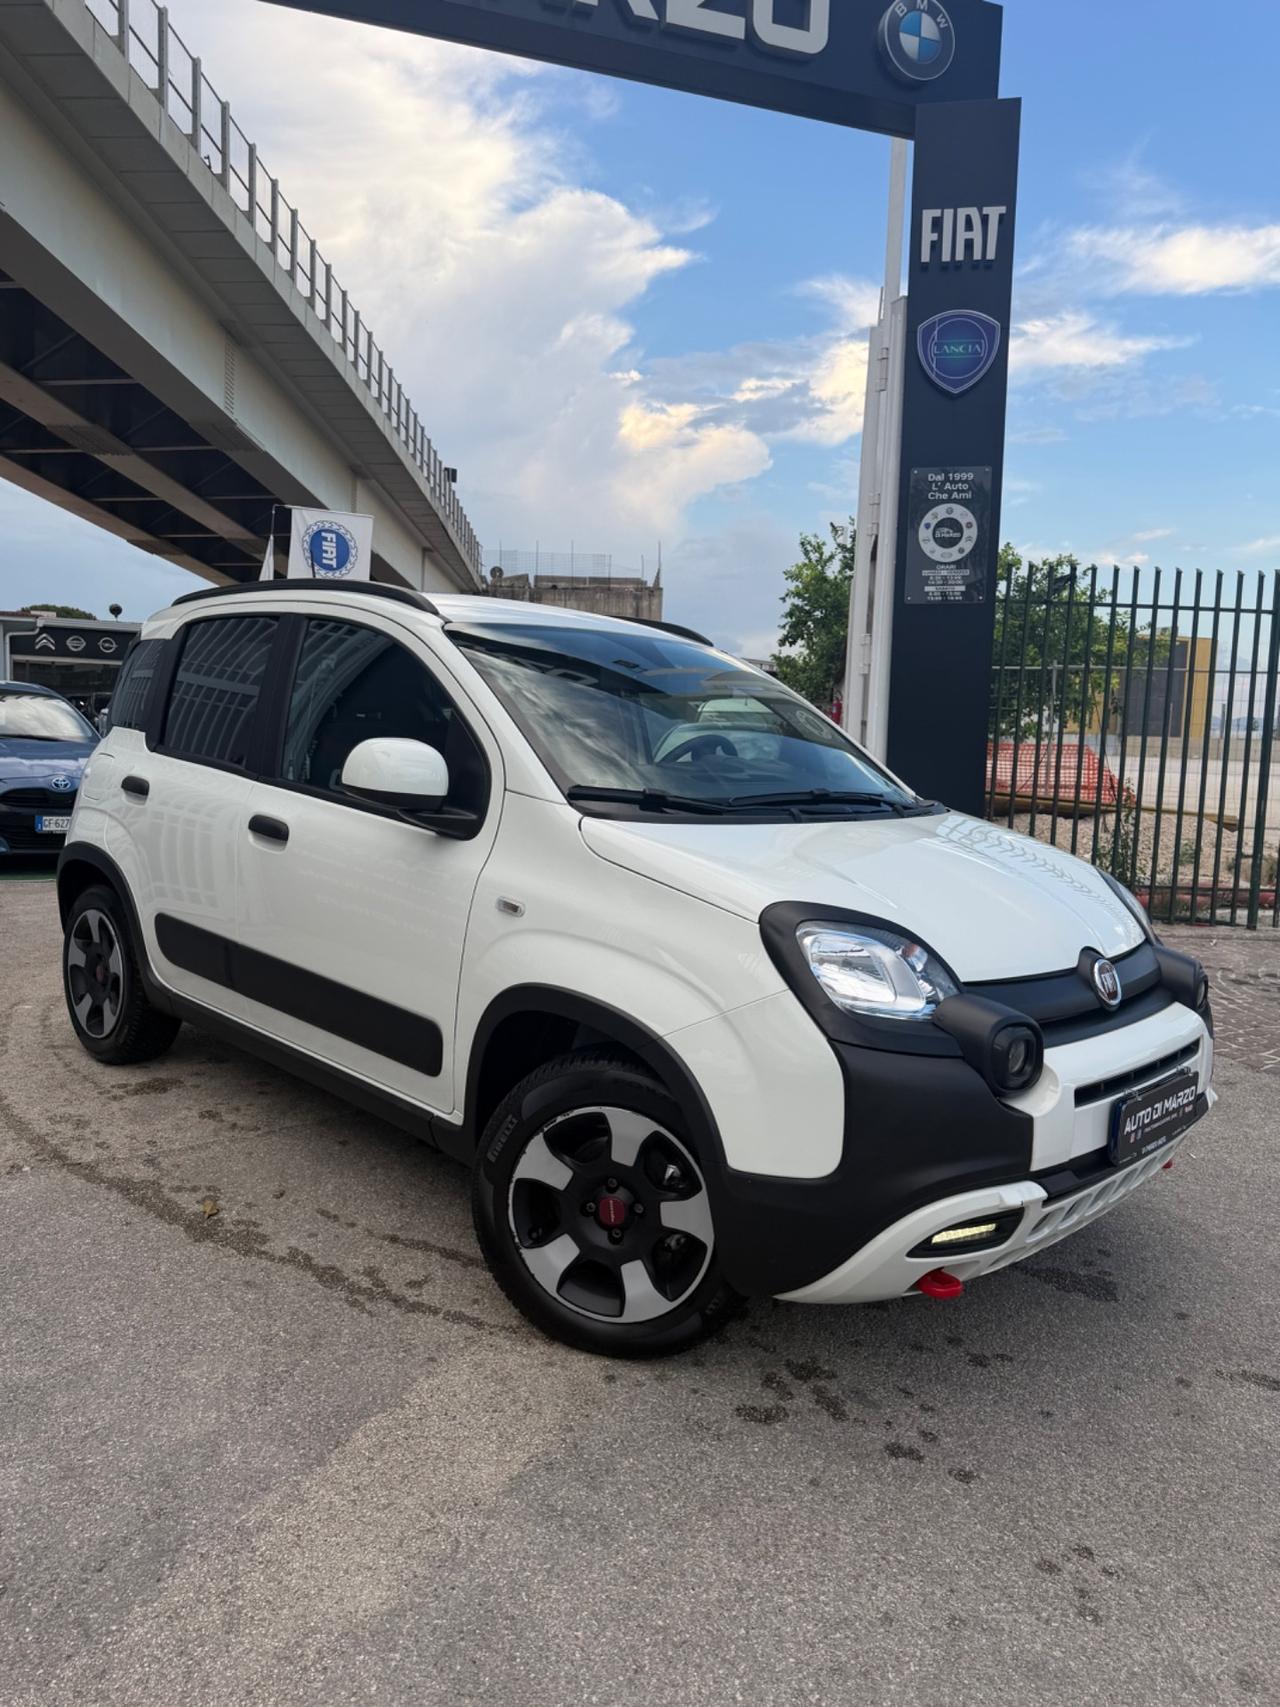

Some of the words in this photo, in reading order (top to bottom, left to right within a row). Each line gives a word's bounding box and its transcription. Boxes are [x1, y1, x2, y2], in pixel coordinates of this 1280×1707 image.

[894, 0, 948, 28] BMW
[920, 205, 1007, 263] FIAT
[933, 342, 983, 354] LANCIA
[928, 473, 945, 482] Dal
[948, 472, 974, 481] 1999
[943, 482, 969, 490] Auto
[928, 491, 949, 500] Che
[951, 490, 972, 499] Ami
[321, 532, 337, 568] FIAT
[1124, 1107, 1152, 1136] AUTO
[1152, 1101, 1163, 1120] DI
[1163, 1085, 1196, 1115] MARZO
[486, 1113, 519, 1163] PIRELLI
